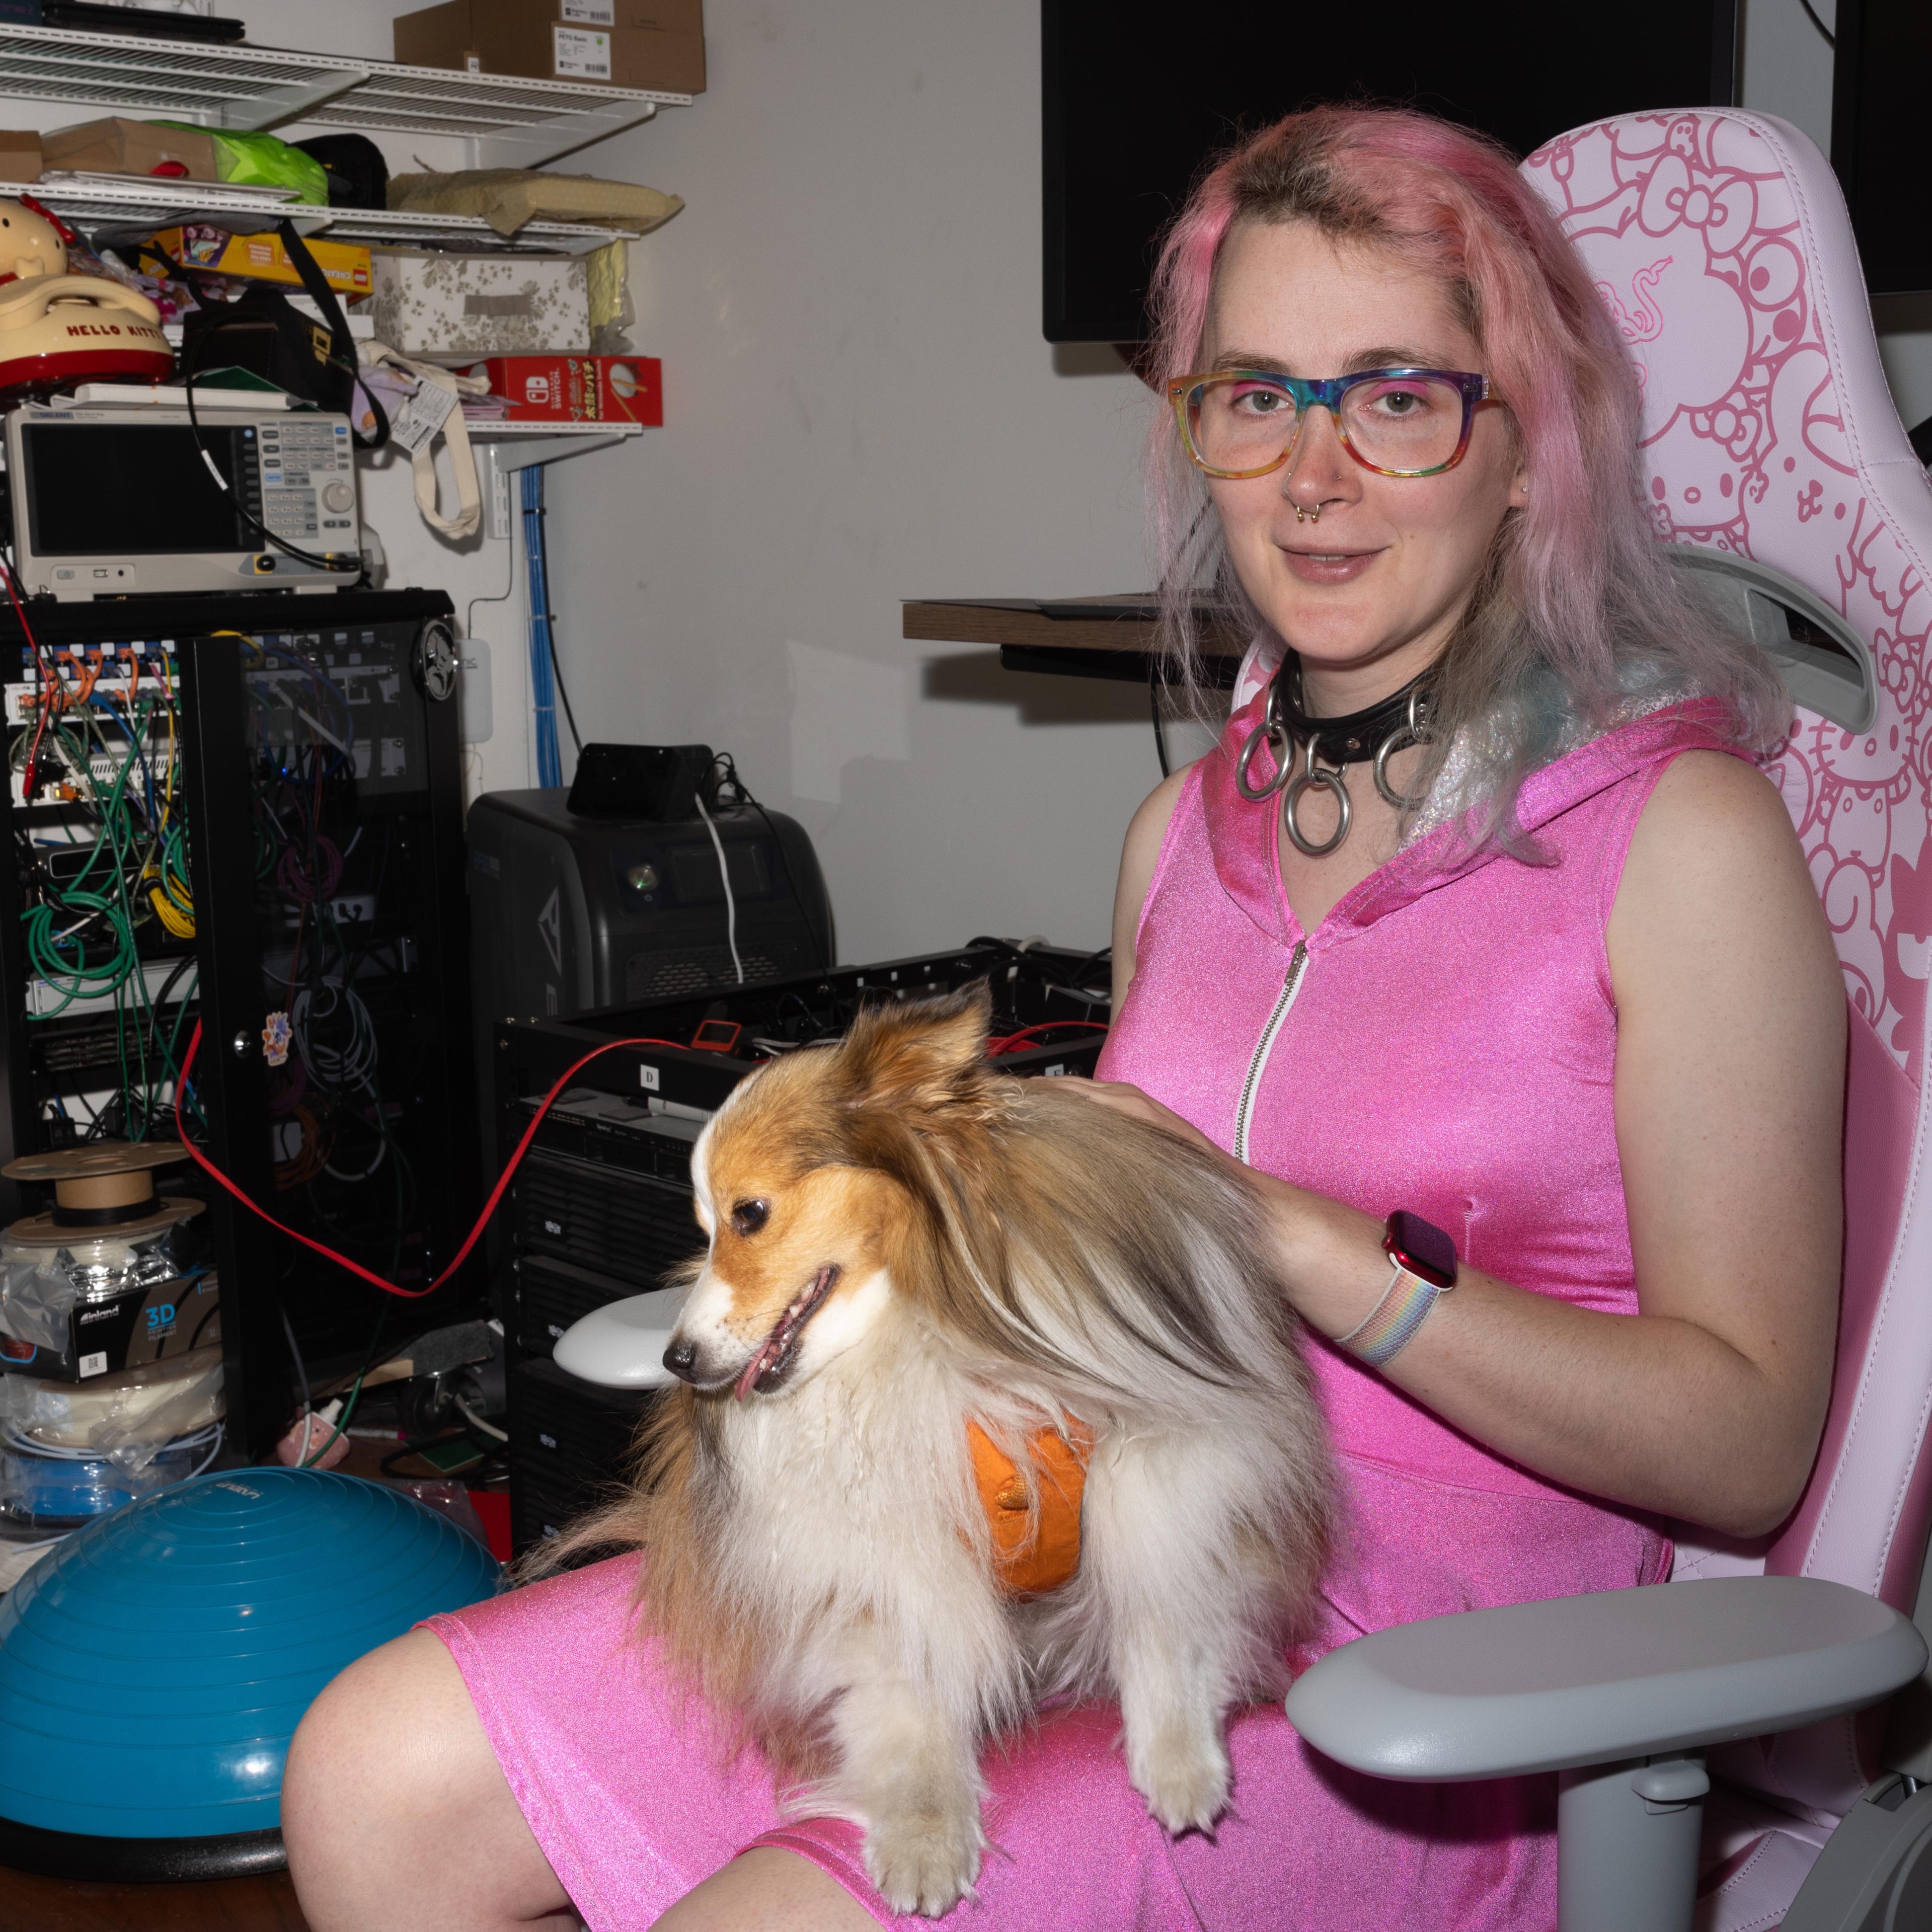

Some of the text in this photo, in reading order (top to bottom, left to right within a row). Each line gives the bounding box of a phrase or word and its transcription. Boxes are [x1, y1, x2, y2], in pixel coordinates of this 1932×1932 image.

[321, 268, 351, 280] CREATO
[66, 324, 162, 340] HELLO KITTY
[646, 1071, 653, 1083] D
[88, 1305, 119, 1323] inland
[146, 1303, 176, 1327] 3D
[147, 1324, 177, 1336] PRINTING
[148, 1330, 177, 1342] FILAMENT
